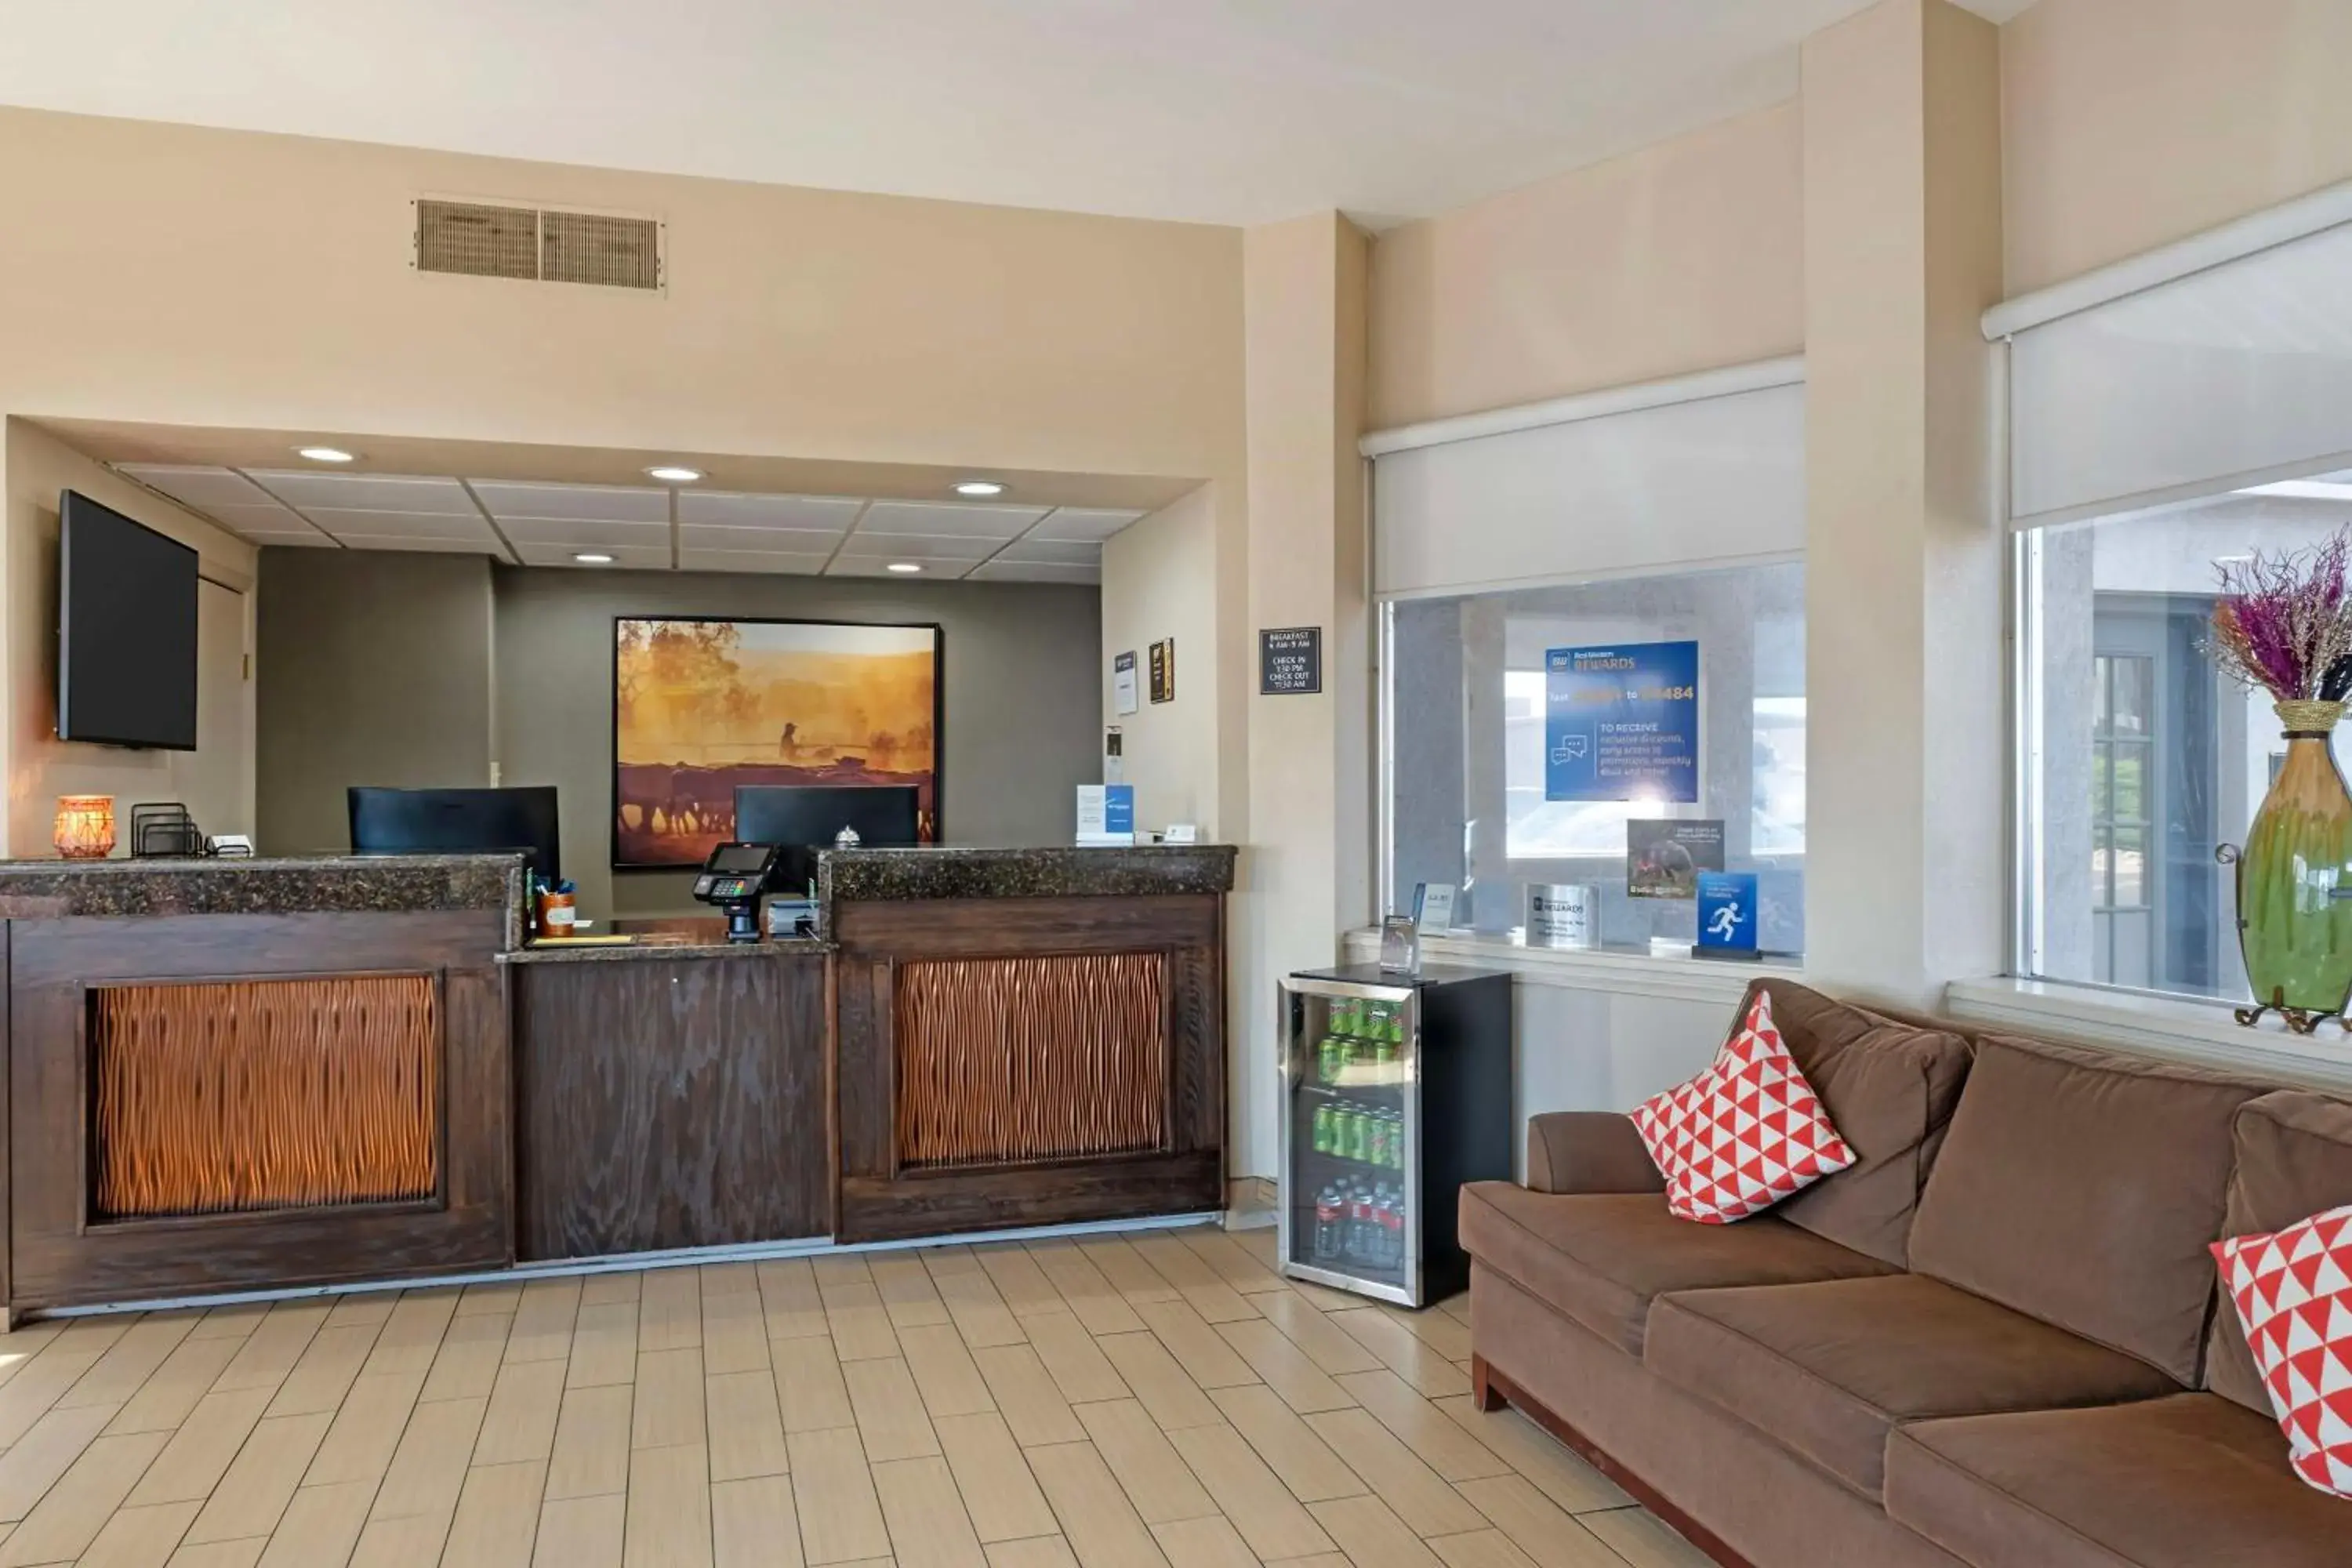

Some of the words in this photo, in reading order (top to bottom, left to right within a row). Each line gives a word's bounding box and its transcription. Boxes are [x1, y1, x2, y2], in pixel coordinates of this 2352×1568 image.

[1270, 632, 1308, 641] BREAKFAST
[1272, 656, 1296, 665] CHECK
[1573, 657, 1635, 670] REWARDS
[1627, 691, 1638, 699] to
[1600, 724, 1614, 732] TO
[1616, 723, 1658, 732] RECEIVE
